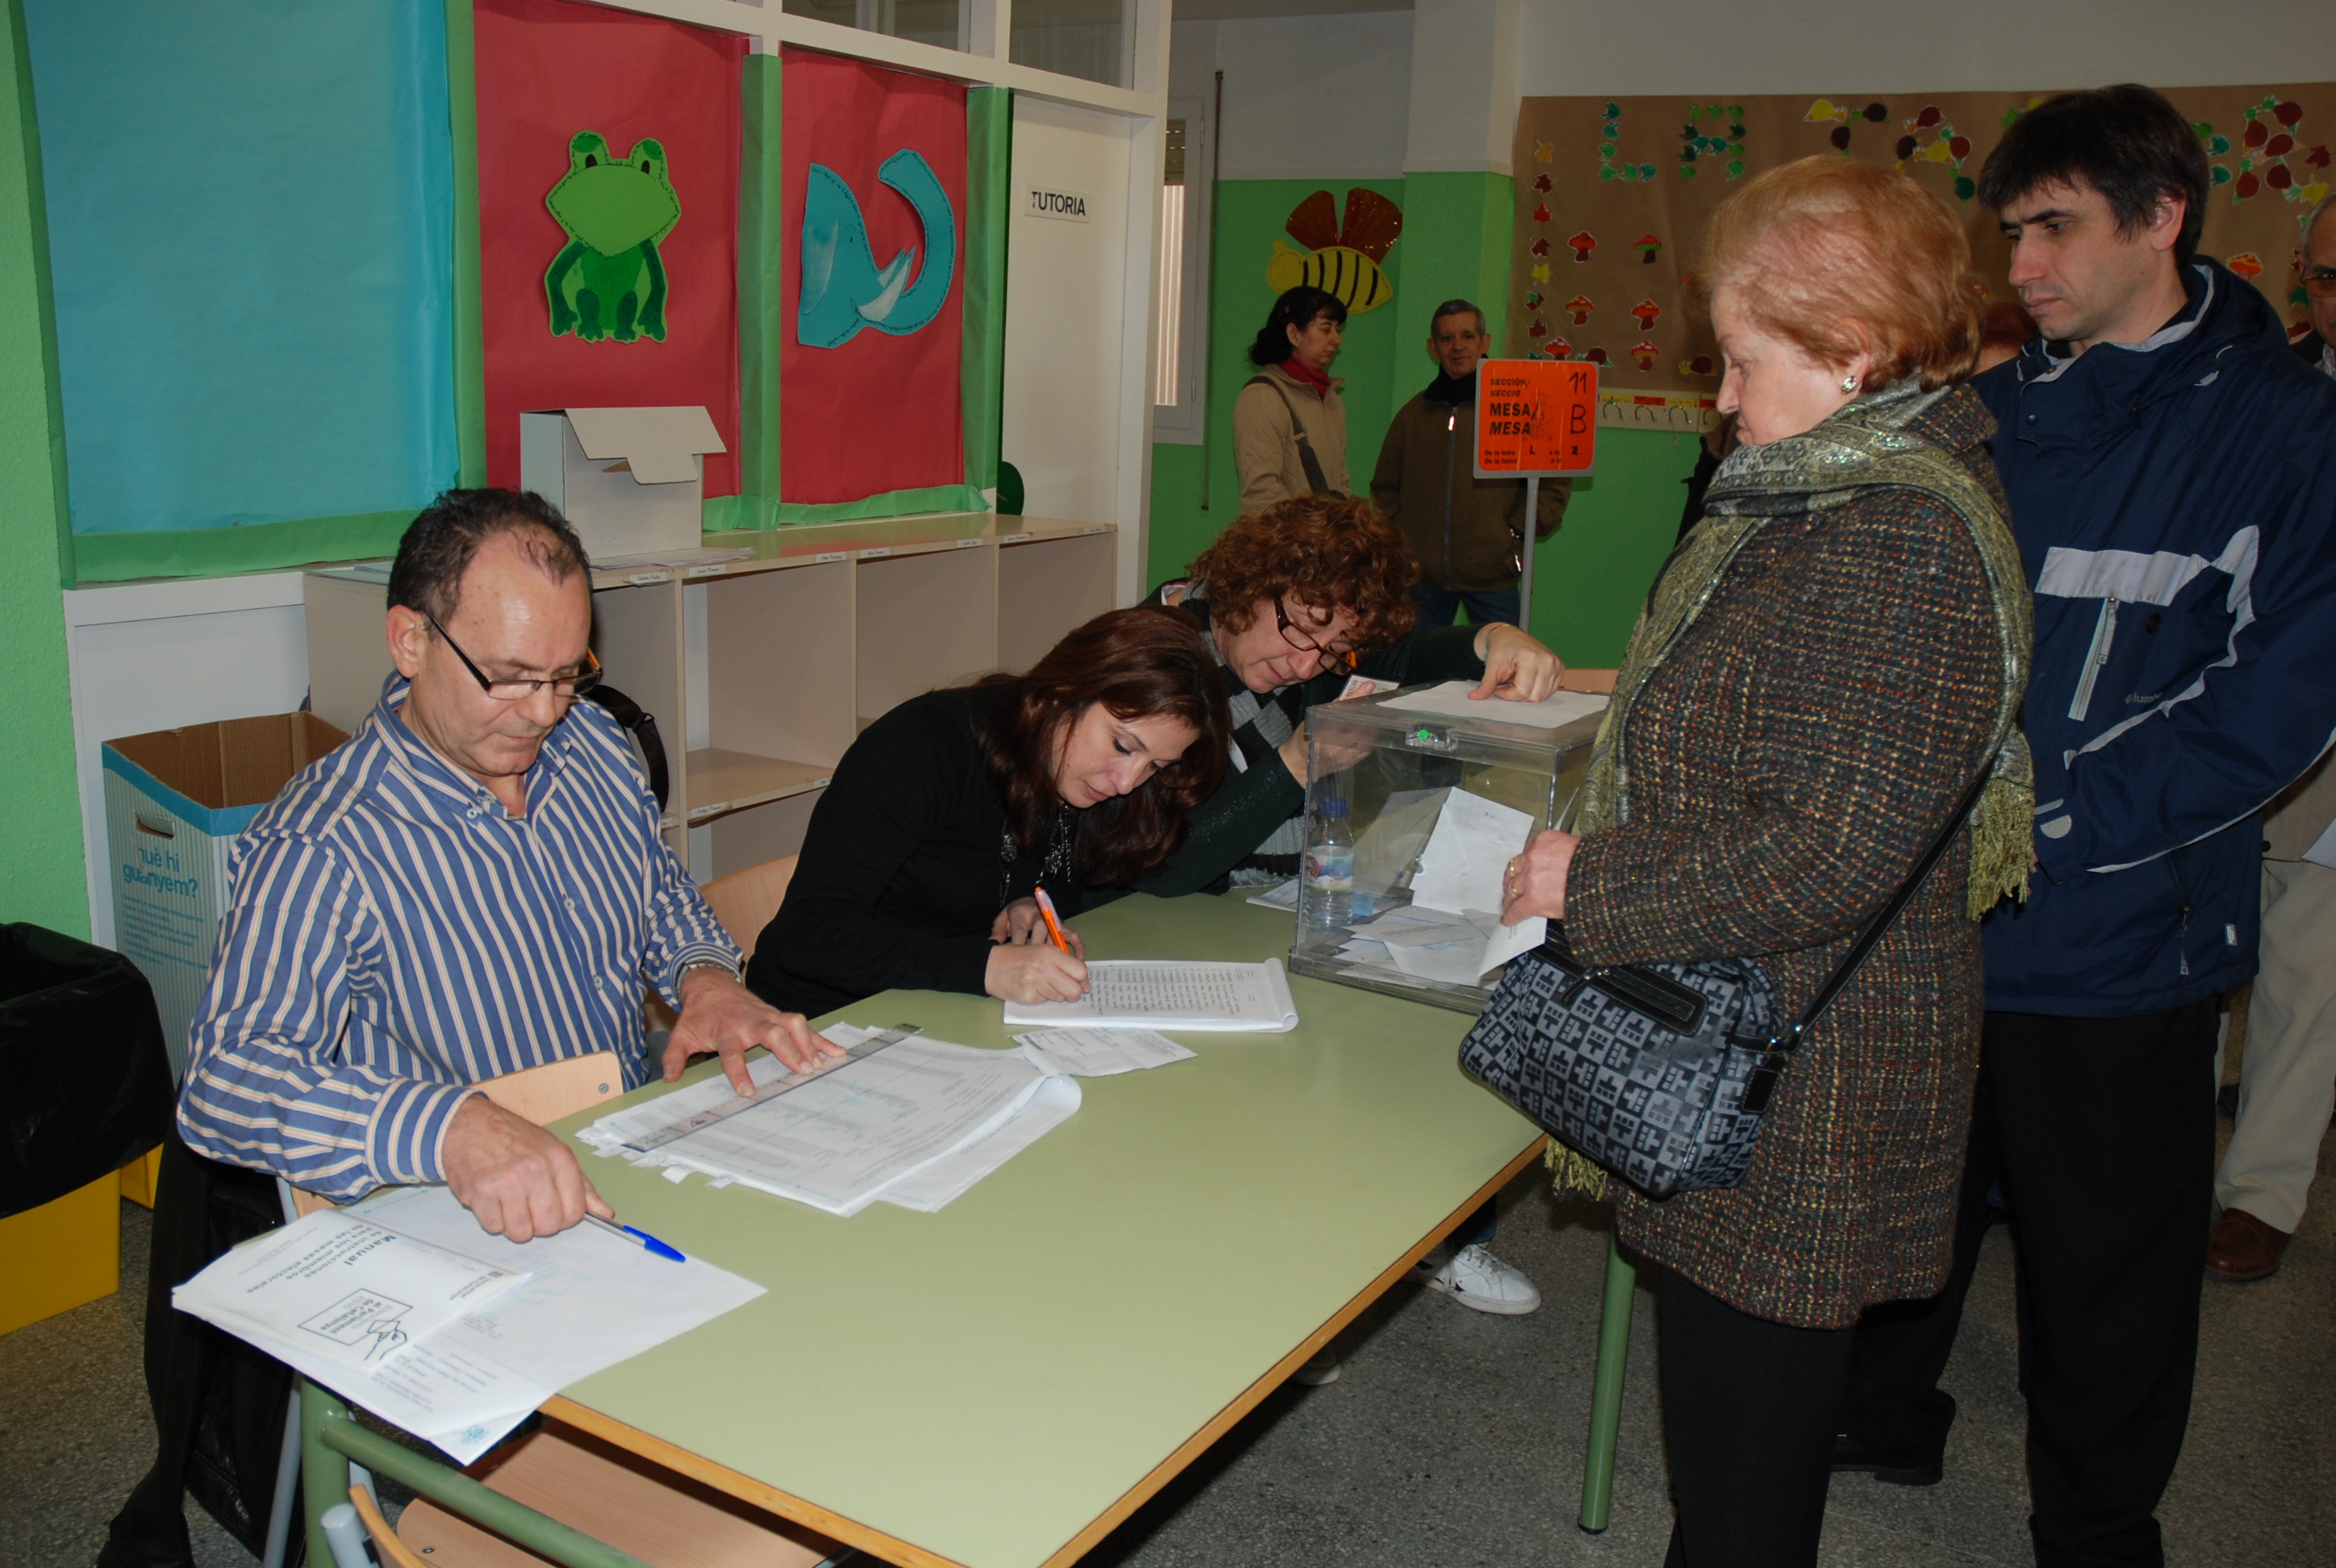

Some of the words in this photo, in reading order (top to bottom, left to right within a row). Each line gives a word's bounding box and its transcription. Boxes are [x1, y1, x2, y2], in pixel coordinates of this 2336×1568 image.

[1031, 191, 1086, 216] TUTORIA
[1569, 371, 1587, 394] 11
[1489, 421, 1531, 436] MESA
[1570, 404, 1587, 434] B
[165, 850, 180, 873] hi
[123, 864, 198, 898] guanyem?
[334, 1238, 352, 1249] los
[335, 1231, 352, 1240] las
[351, 1227, 373, 1240] para
[302, 1240, 334, 1261] mesas
[304, 1237, 369, 1278] instrucciones
[344, 1234, 397, 1266] Manual
[286, 1249, 334, 1280] miembros
[246, 1261, 302, 1294] electorales
[319, 1306, 364, 1331] Catalunya
[329, 1307, 375, 1334] Parlament
